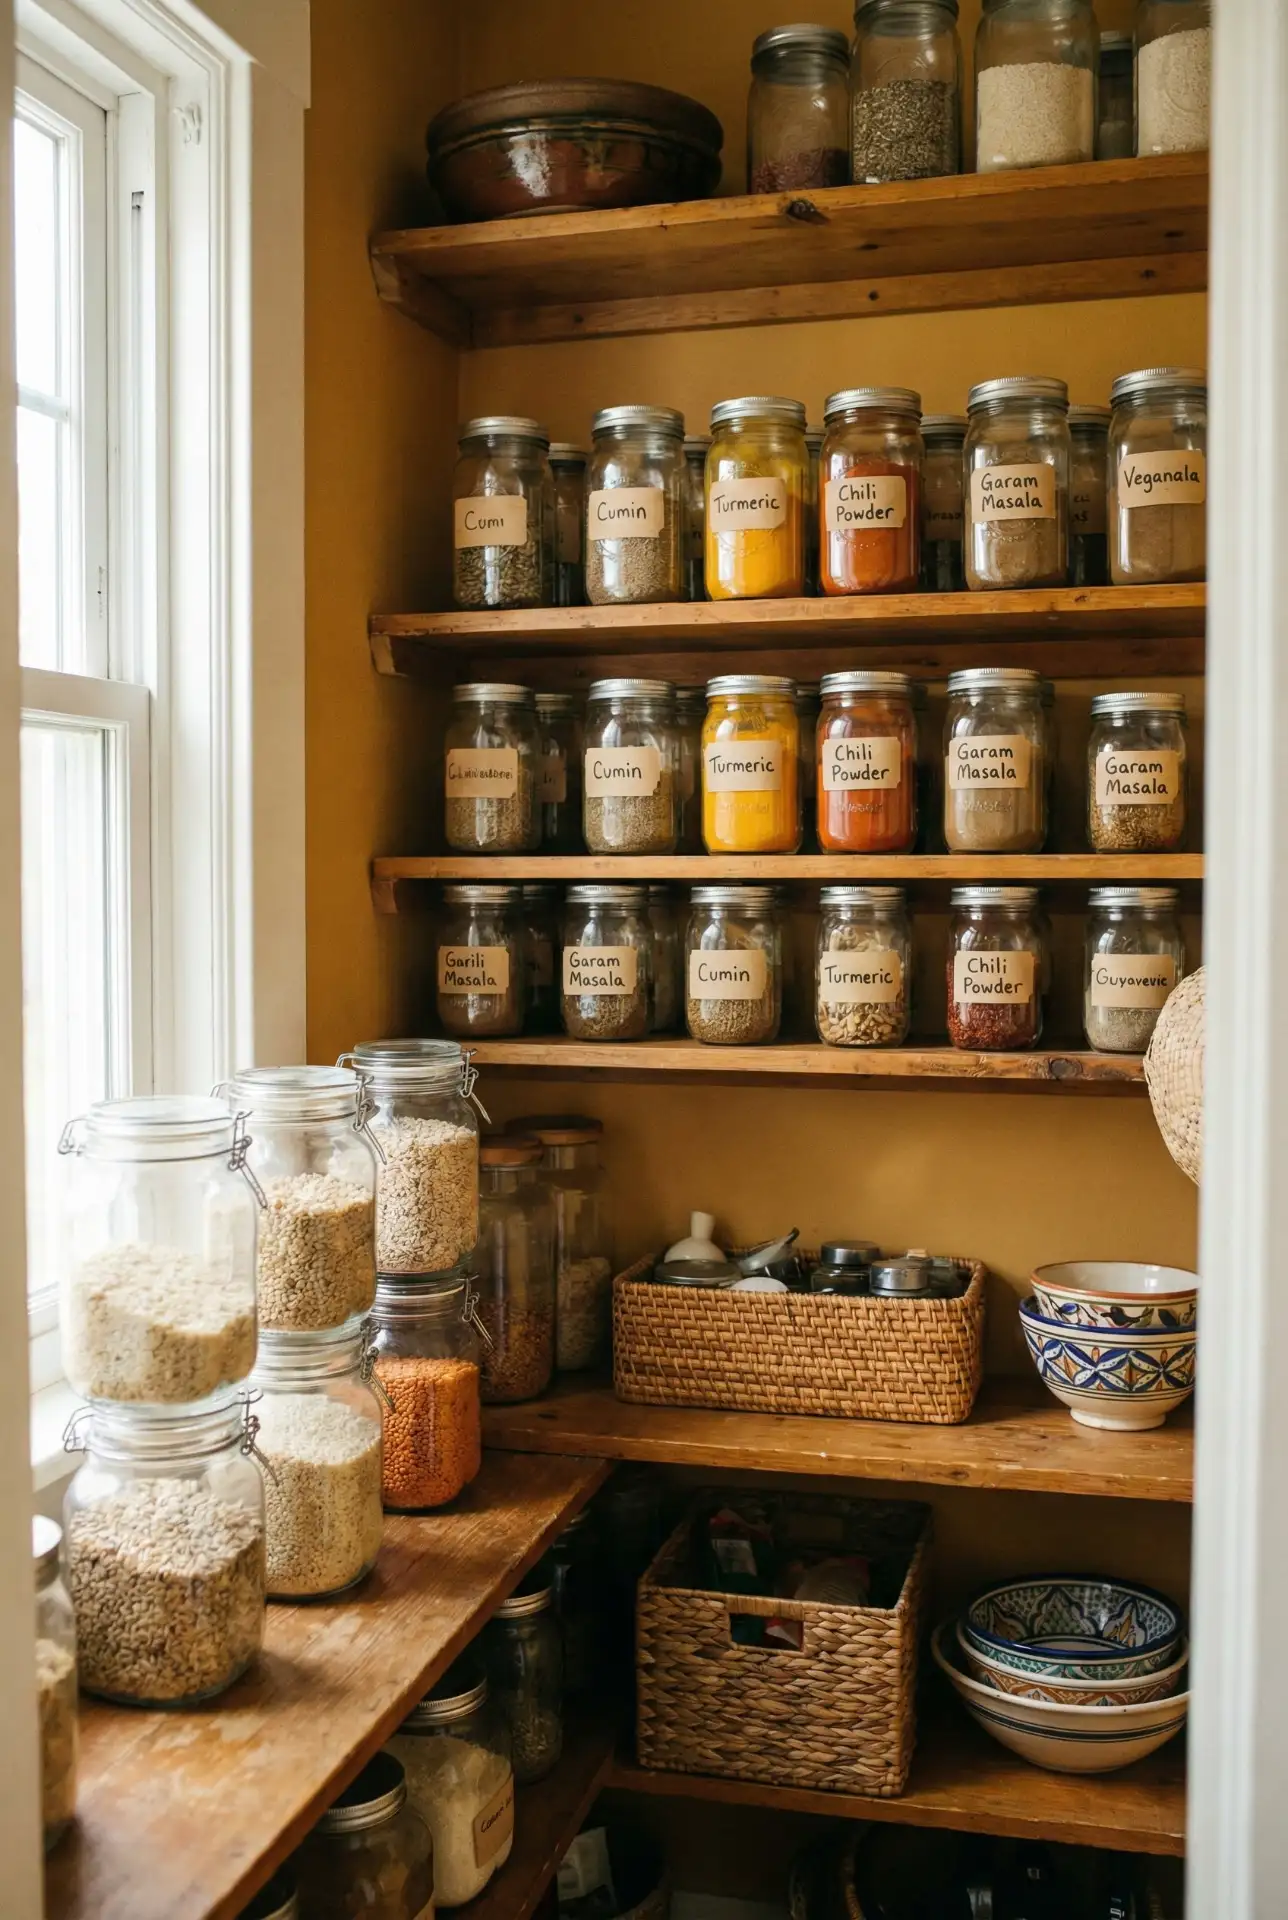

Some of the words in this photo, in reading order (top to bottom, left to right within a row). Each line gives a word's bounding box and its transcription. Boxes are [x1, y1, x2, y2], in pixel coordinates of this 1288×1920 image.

[981, 473, 1038, 491] Garam
[1124, 466, 1200, 493] Veganala
[839, 483, 876, 503] Chili
[981, 492, 1043, 512] Masala
[597, 501, 646, 521] Cumin
[714, 493, 780, 514] Turmeric
[836, 504, 894, 522] Powder
[835, 744, 872, 762] Chili
[957, 743, 1013, 759] Garam
[594, 760, 642, 780] Cumin
[709, 756, 775, 773] Turmeric
[832, 764, 890, 782] Powder
[957, 763, 1017, 780] Masala
[1105, 757, 1163, 774] Garam
[1105, 779, 1168, 796] Masala
[570, 951, 620, 968] Garam
[968, 957, 1007, 974] Chili
[445, 971, 497, 987] Masala
[570, 971, 626, 987] Masala
[699, 963, 750, 982] Cumin
[824, 965, 894, 984] Turmeric
[964, 978, 1023, 995] Powder
